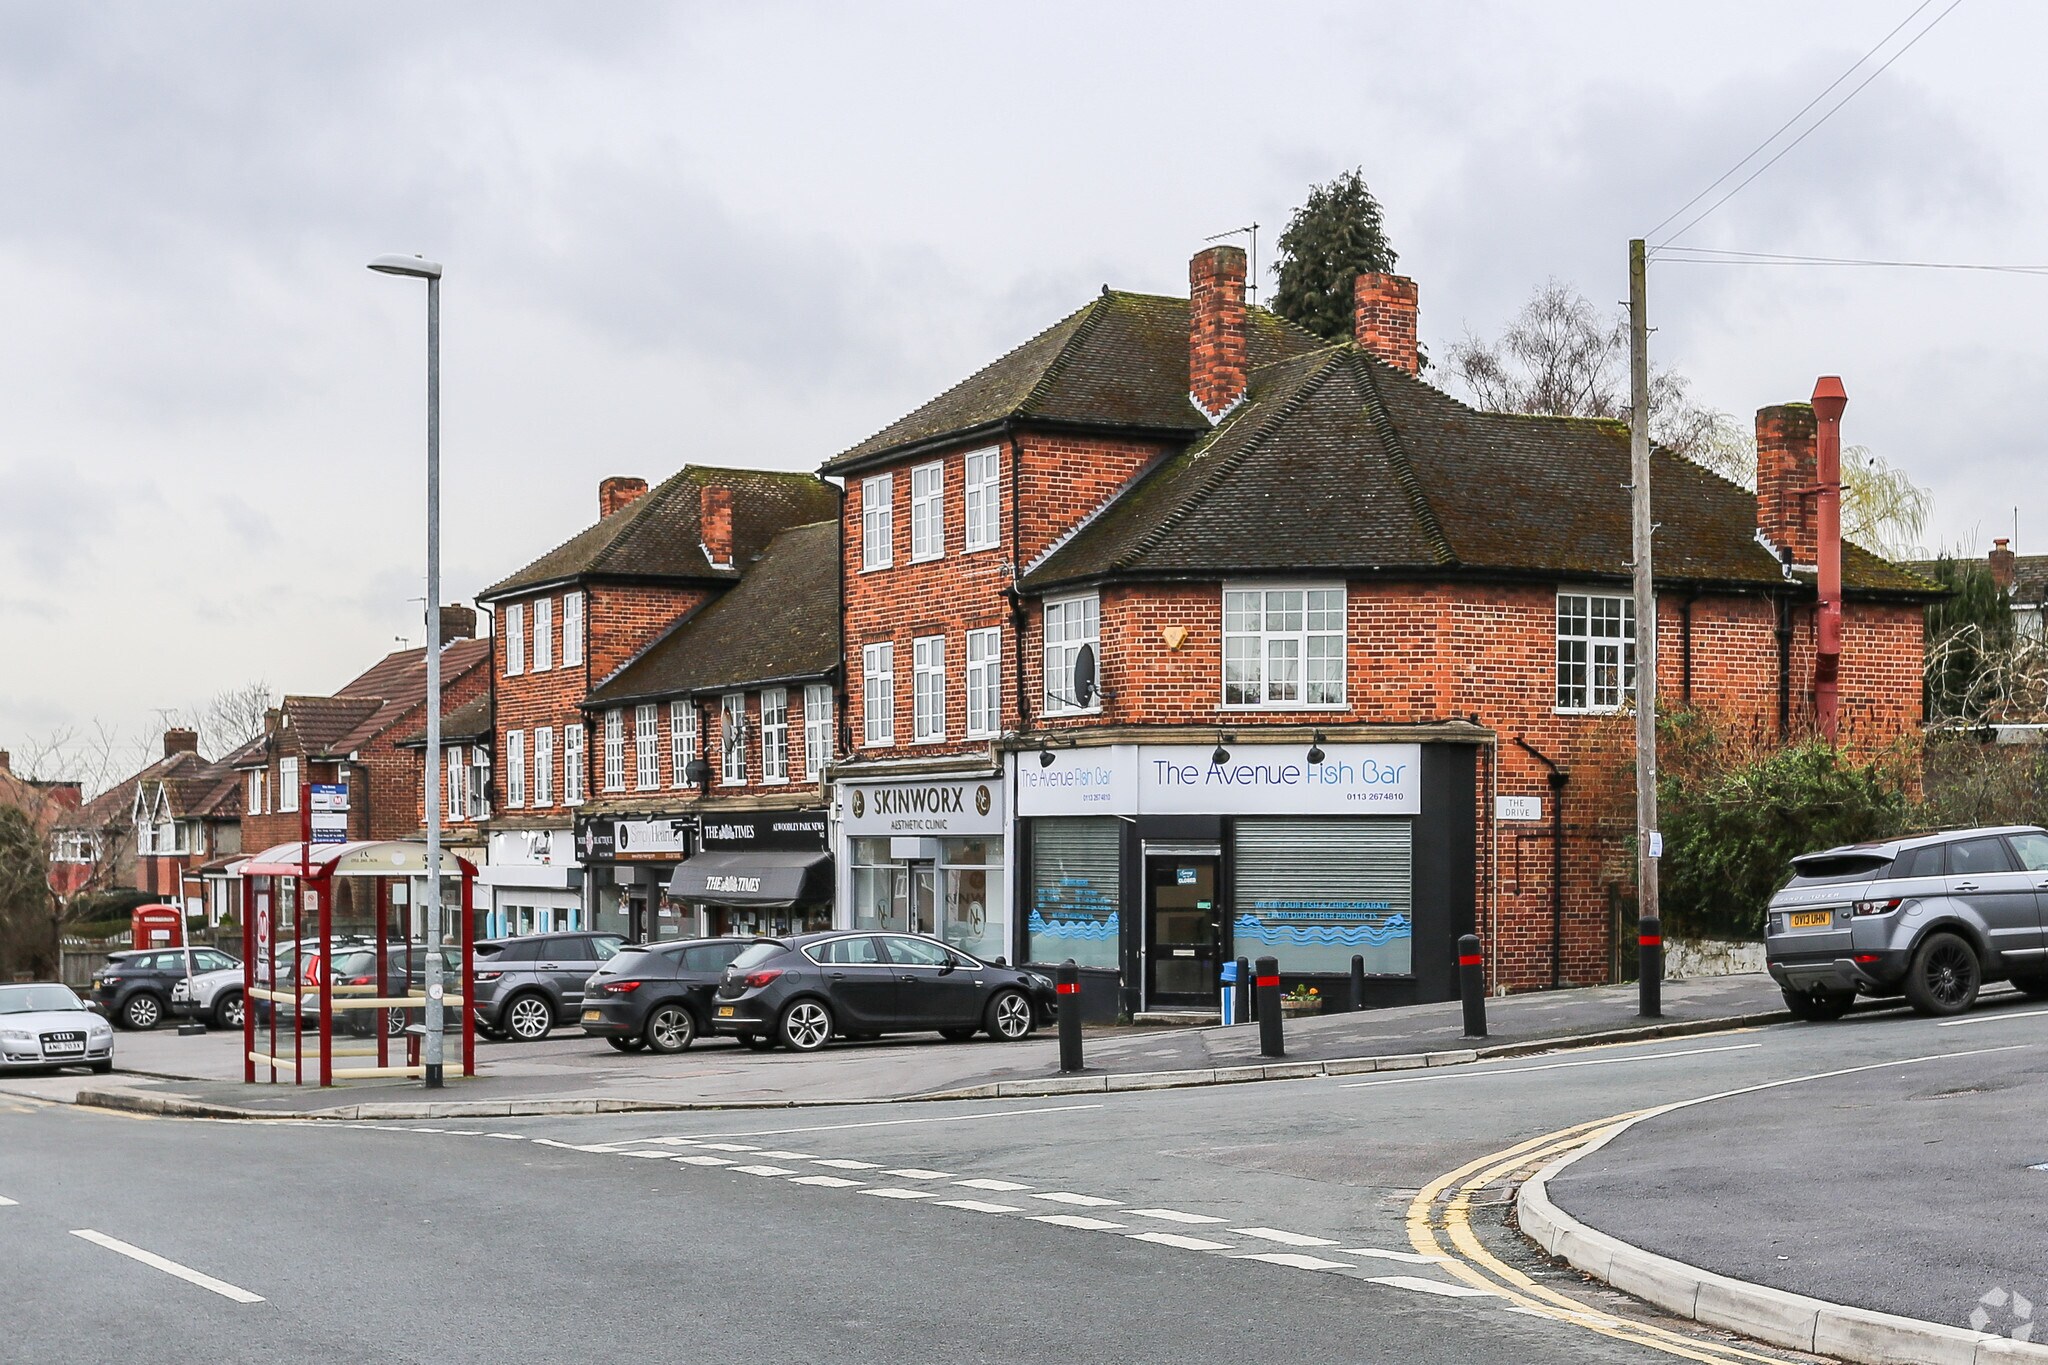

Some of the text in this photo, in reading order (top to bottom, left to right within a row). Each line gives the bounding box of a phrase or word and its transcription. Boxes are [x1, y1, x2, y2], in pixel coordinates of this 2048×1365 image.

[1021, 766, 1112, 788] The Avenue Fish Bar
[1153, 760, 1406, 785] The Avenue Fish Bar
[874, 787, 964, 815] SKINWORX
[1508, 799, 1525, 807] THE
[1505, 808, 1530, 817] DRIVE
[799, 822, 812, 831] PARK
[811, 821, 825, 831] NEWS
[891, 819, 948, 830] AESTHETIC CLINIC
[705, 825, 755, 839] THE TIMES
[706, 876, 761, 892] THE TIMES
[1336, 911, 1378, 919] PRODUCTS
[1794, 912, 1826, 926] OV13 UHN
